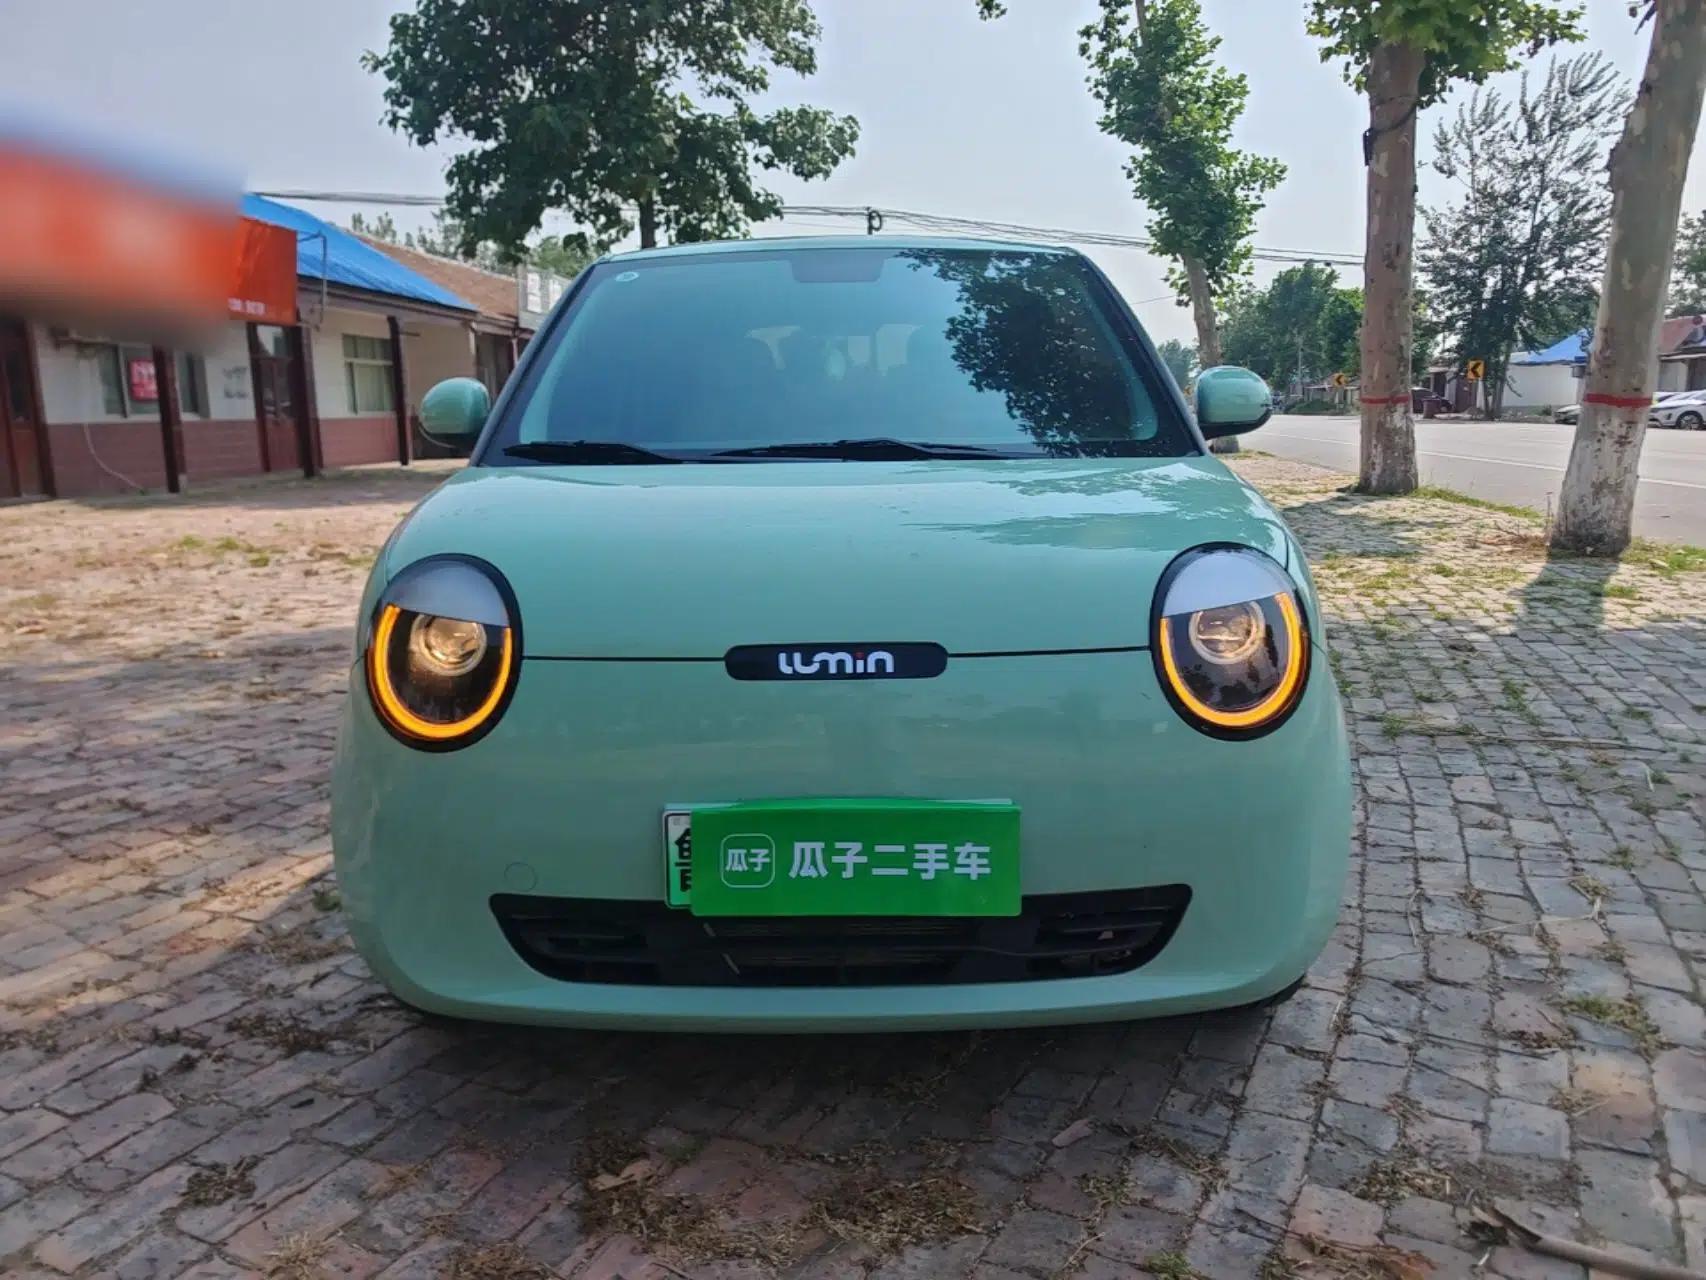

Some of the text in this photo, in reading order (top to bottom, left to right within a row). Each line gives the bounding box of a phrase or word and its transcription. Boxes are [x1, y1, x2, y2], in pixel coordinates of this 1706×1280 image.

[725, 848, 771, 872] 瓜子
[788, 841, 992, 881] 瓜子二手车
